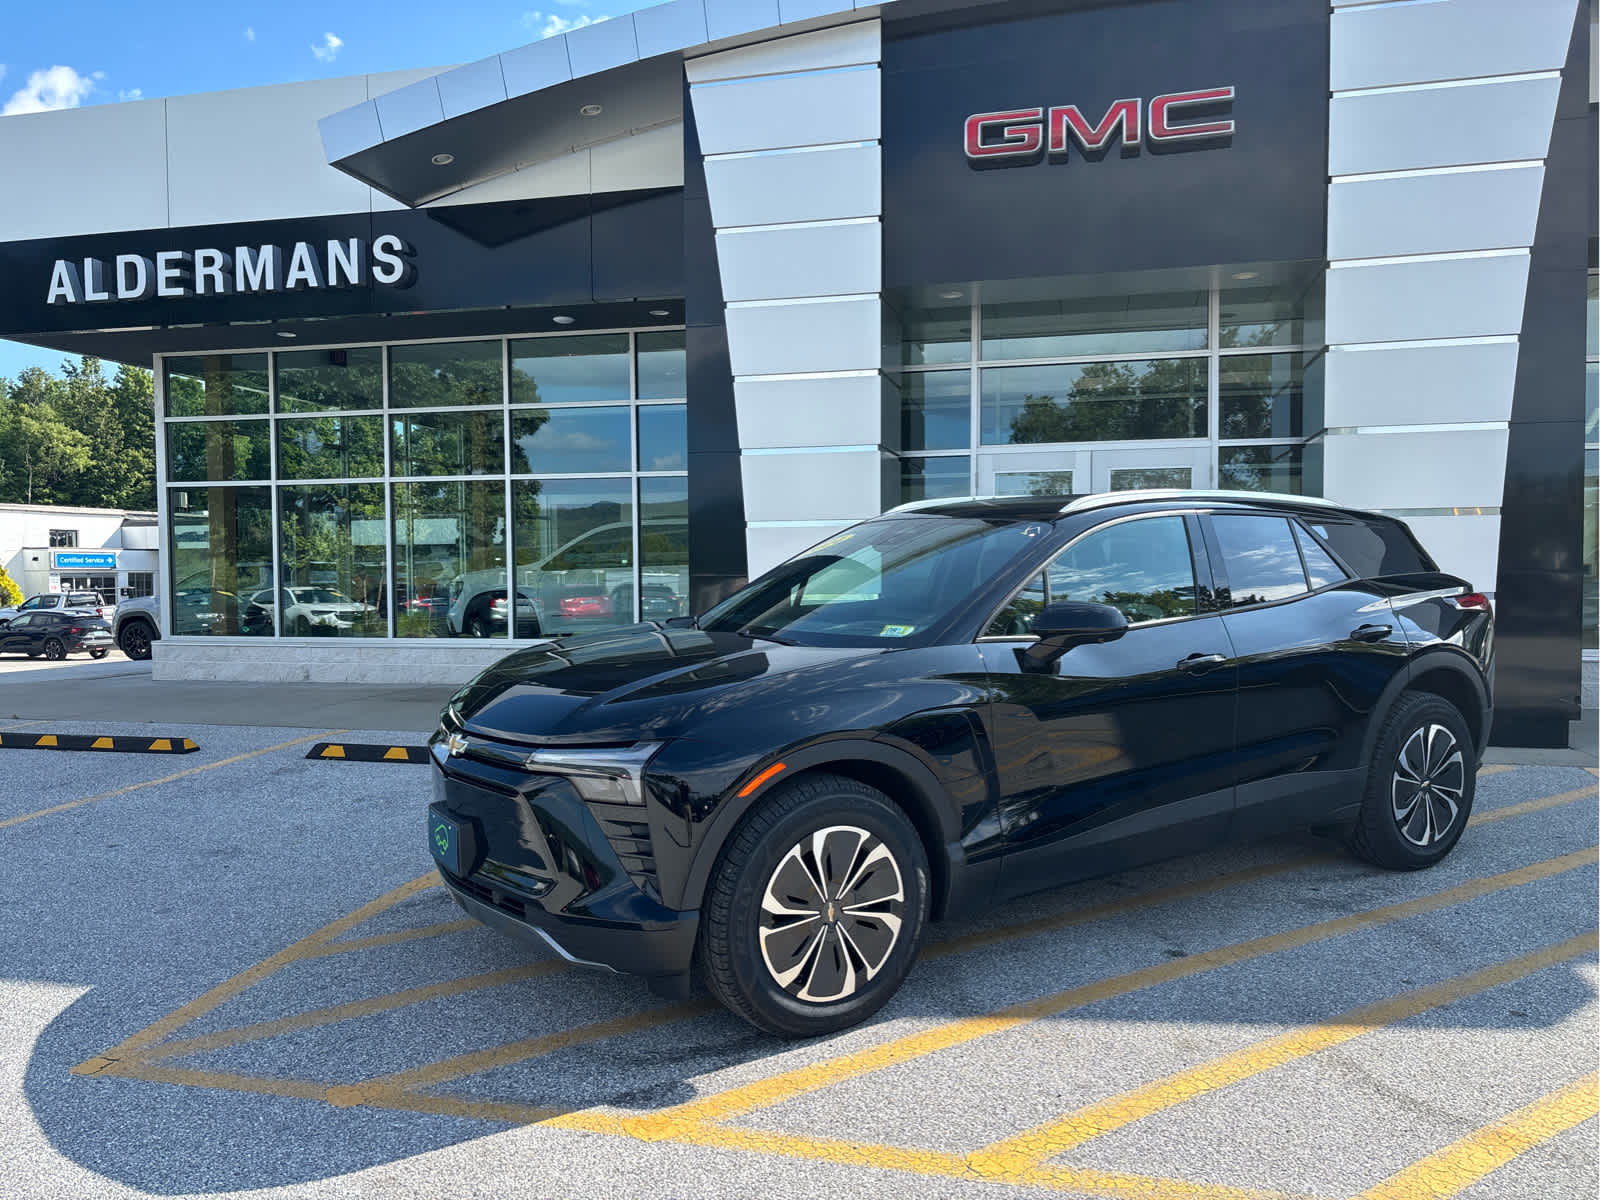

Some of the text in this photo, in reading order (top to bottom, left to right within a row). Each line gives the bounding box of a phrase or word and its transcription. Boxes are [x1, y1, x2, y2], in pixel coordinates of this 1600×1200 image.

[964, 85, 1235, 158] GMC
[46, 234, 404, 304] ALDERMANS
[60, 556, 84, 564] Certified
